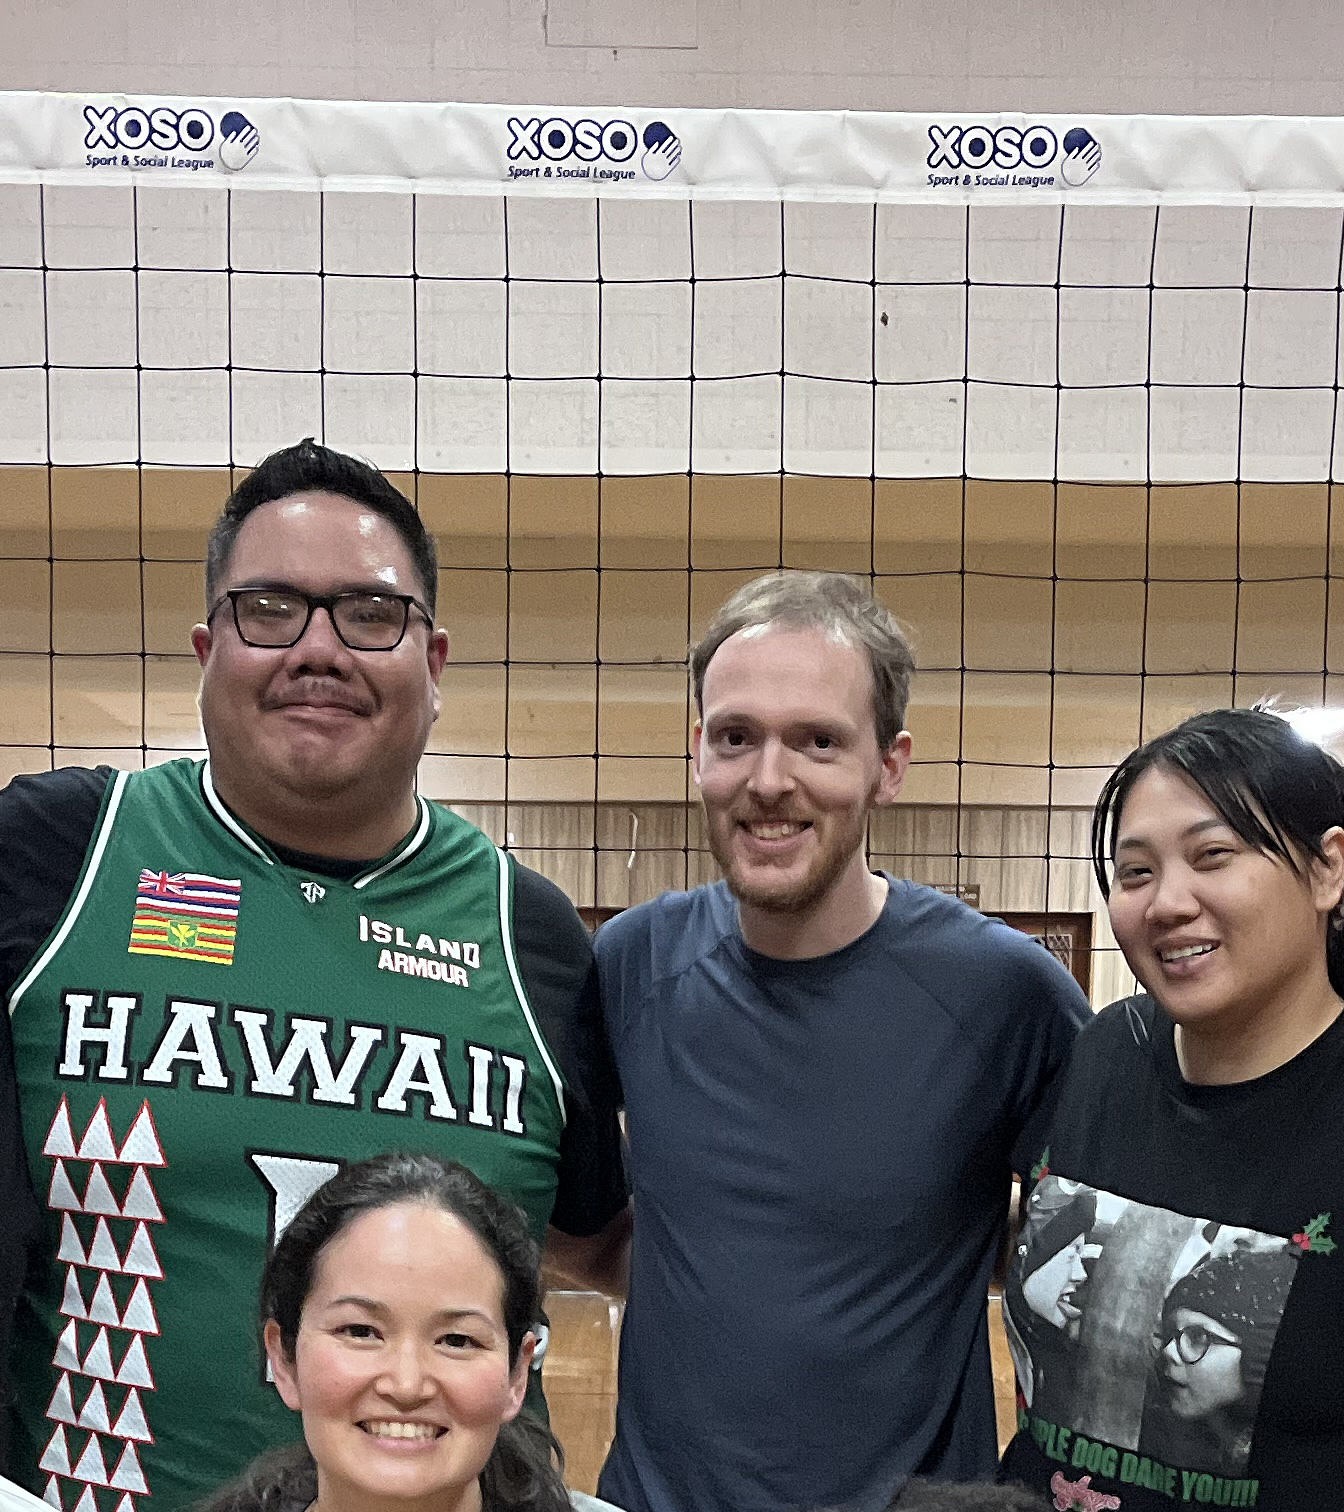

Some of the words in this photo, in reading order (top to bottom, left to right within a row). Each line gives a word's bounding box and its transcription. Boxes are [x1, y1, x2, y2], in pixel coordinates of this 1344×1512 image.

[83, 105, 215, 151] XOSO
[506, 117, 638, 162] XOSO
[926, 125, 1058, 170] XOSO
[86, 154, 117, 168] Sport
[133, 155, 168, 167] Social
[171, 156, 215, 171] League
[508, 165, 540, 180] Sport
[556, 166, 591, 178] Social
[594, 166, 636, 182] League
[926, 174, 959, 188] Sport
[974, 174, 1010, 186] Social
[1012, 174, 1055, 188] League
[359, 914, 481, 970] ISLAND
[377, 948, 470, 988] ARMOUR
[57, 990, 528, 1138] HAWAII
[1071, 1437, 1119, 1480] DOG
[1120, 1452, 1178, 1500] DARE
